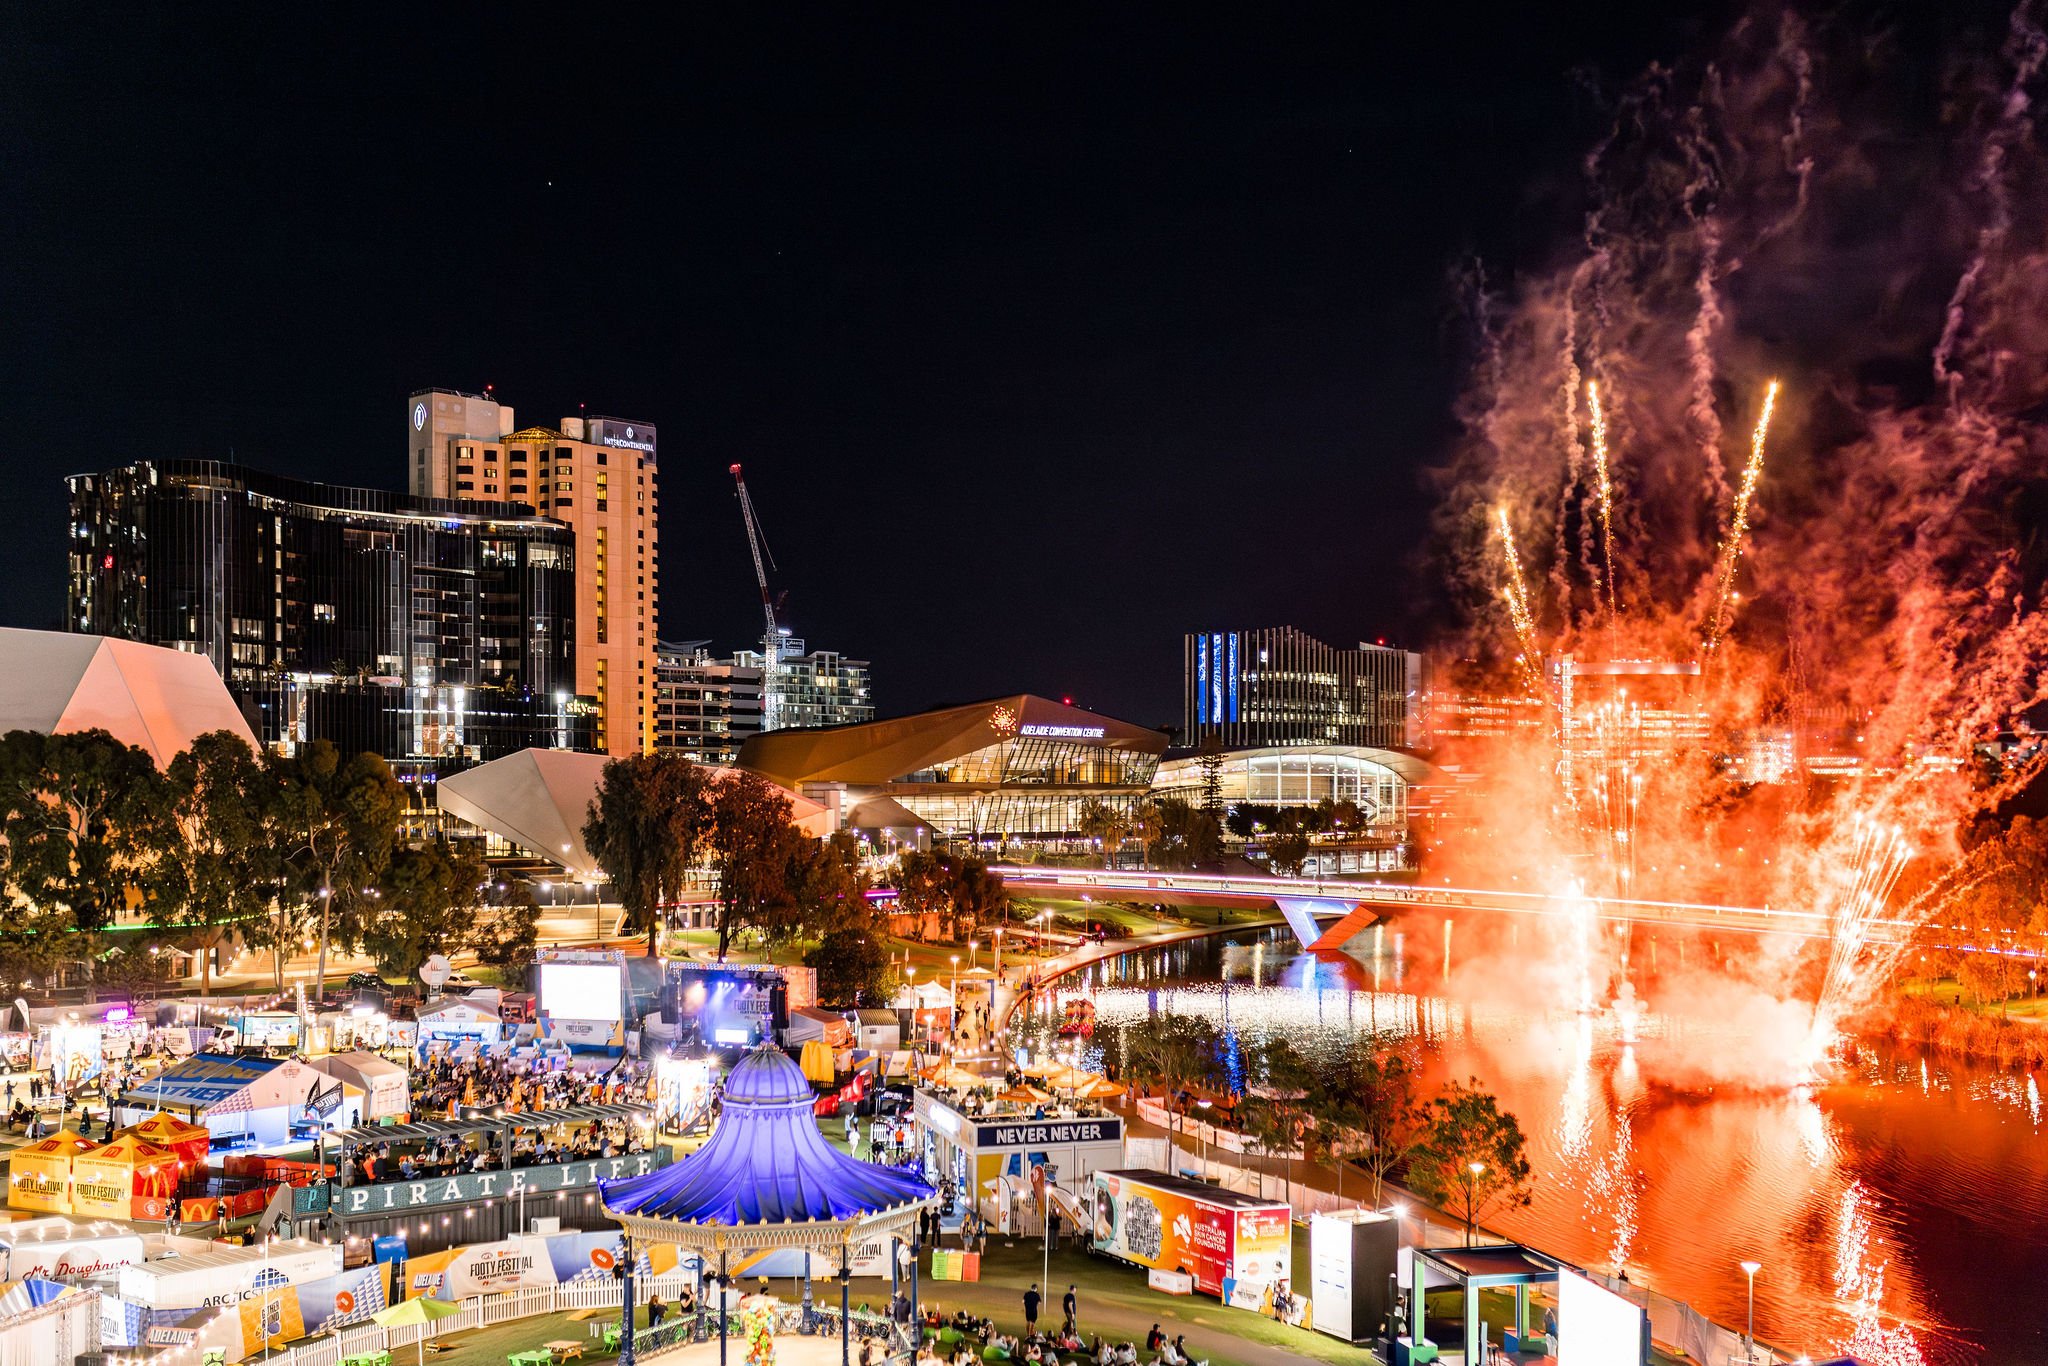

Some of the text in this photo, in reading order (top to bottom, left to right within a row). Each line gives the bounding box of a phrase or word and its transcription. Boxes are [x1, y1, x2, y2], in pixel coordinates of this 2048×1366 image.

[1020, 725, 1104, 738] ADELAIDE CONVENTION CENTRE
[137, 1085, 240, 1102] GATHER
[996, 1124, 1102, 1144] NEVER NEVER
[76, 1183, 97, 1196] FOOTY
[351, 1156, 652, 1212] PIRATE LIFE
[1194, 1222, 1227, 1239] AUSTRALIAN
[1194, 1230, 1227, 1246] SKIN CANCER
[1193, 1236, 1227, 1254] FOUNDATION
[22, 1264, 49, 1281] Mr
[470, 1261, 496, 1277] FOOTY
[477, 1272, 502, 1281] GATHER
[413, 1273, 444, 1288] ADELAIDE
[262, 1300, 280, 1320] GTHER
[148, 1329, 194, 1346] ADELAIDE
